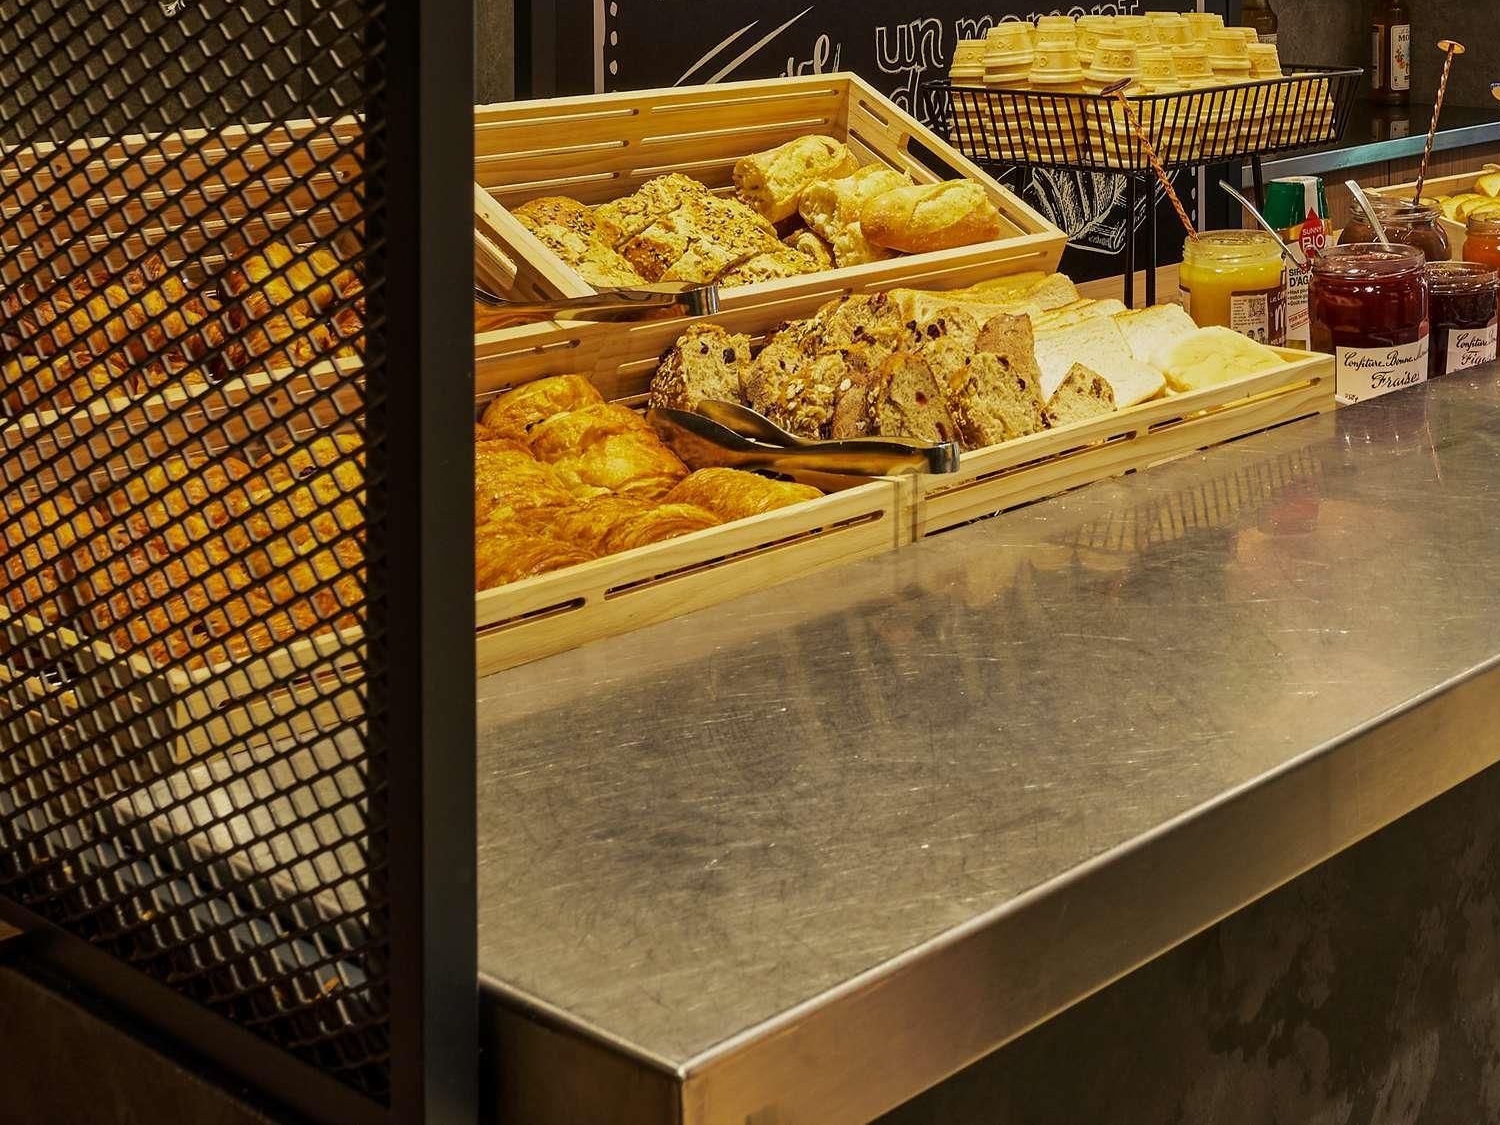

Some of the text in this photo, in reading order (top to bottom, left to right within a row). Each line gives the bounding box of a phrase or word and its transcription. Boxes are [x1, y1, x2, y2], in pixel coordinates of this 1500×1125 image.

[875, 16, 944, 73] un
[1302, 225, 1323, 236] SUNNY
[1302, 233, 1326, 251] BIO
[1343, 351, 1384, 371] Confiture
